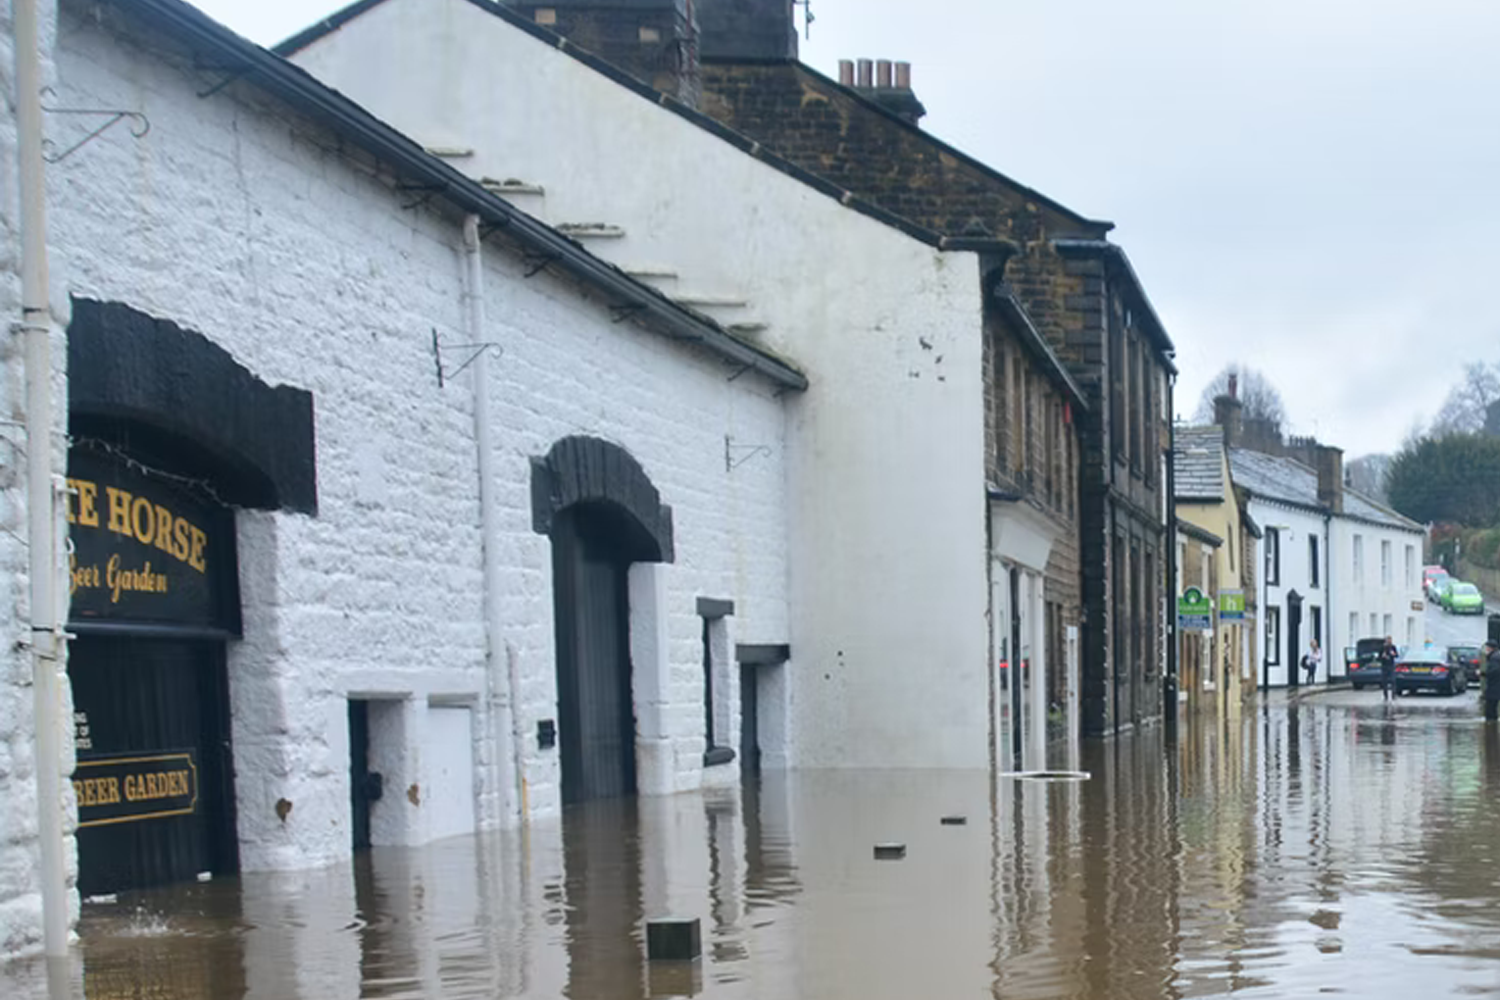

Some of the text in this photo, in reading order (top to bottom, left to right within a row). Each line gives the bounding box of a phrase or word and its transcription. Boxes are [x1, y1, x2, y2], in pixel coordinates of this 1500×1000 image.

[106, 485, 207, 573] HORSE
[107, 553, 168, 603] Garden
[74, 769, 189, 806] BEER GARDEN
